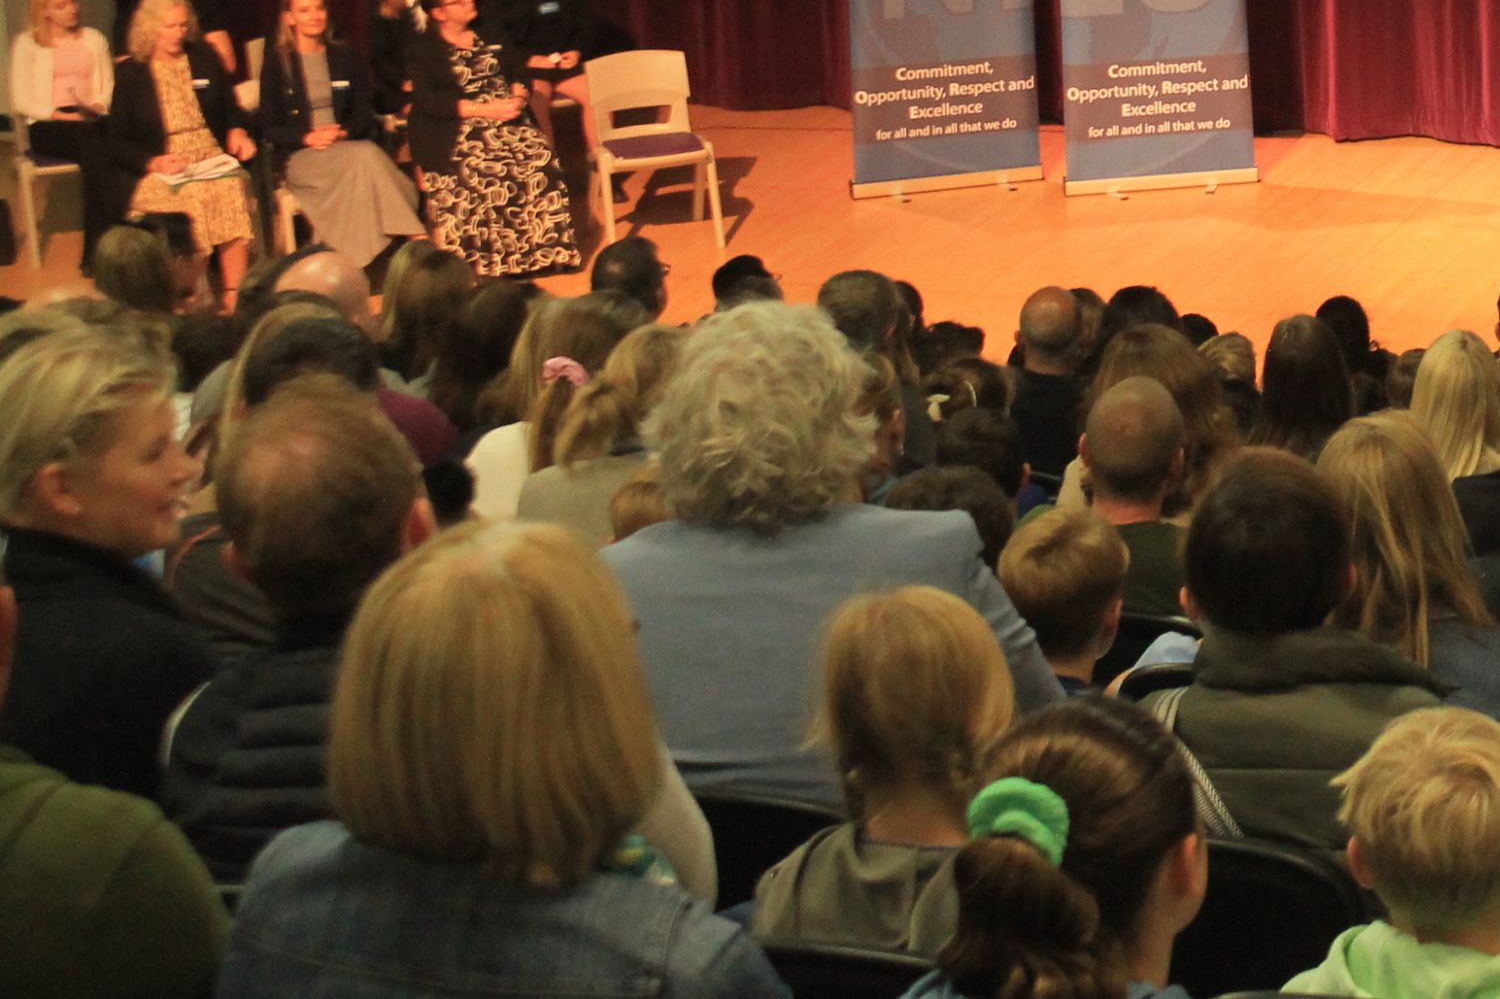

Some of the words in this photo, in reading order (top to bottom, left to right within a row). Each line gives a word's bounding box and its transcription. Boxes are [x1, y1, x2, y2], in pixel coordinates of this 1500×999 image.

[895, 62, 994, 80] Commitment,
[1108, 61, 1206, 78] Commitment,
[854, 86, 946, 106] Opportunity,
[949, 80, 1006, 96] Respect
[1008, 76, 1034, 91] and
[1066, 84, 1159, 103] Opportunity,
[1162, 79, 1219, 95] Respect
[1221, 74, 1248, 90] and
[909, 103, 983, 119] Excellence
[1122, 101, 1196, 116] Excellence
[876, 129, 892, 140] for
[894, 127, 907, 139] all
[908, 125, 930, 137] and
[932, 125, 943, 135] in
[944, 123, 958, 134] all
[959, 122, 982, 132] that
[983, 121, 1000, 130] we
[1001, 118, 1017, 129] do
[1088, 126, 1104, 138] for
[1106, 125, 1119, 136] all
[1121, 123, 1142, 135] and
[1144, 123, 1156, 134] in
[1157, 121, 1170, 133] all
[1172, 120, 1195, 131] that
[1197, 120, 1214, 130] we
[1215, 117, 1231, 128] do
